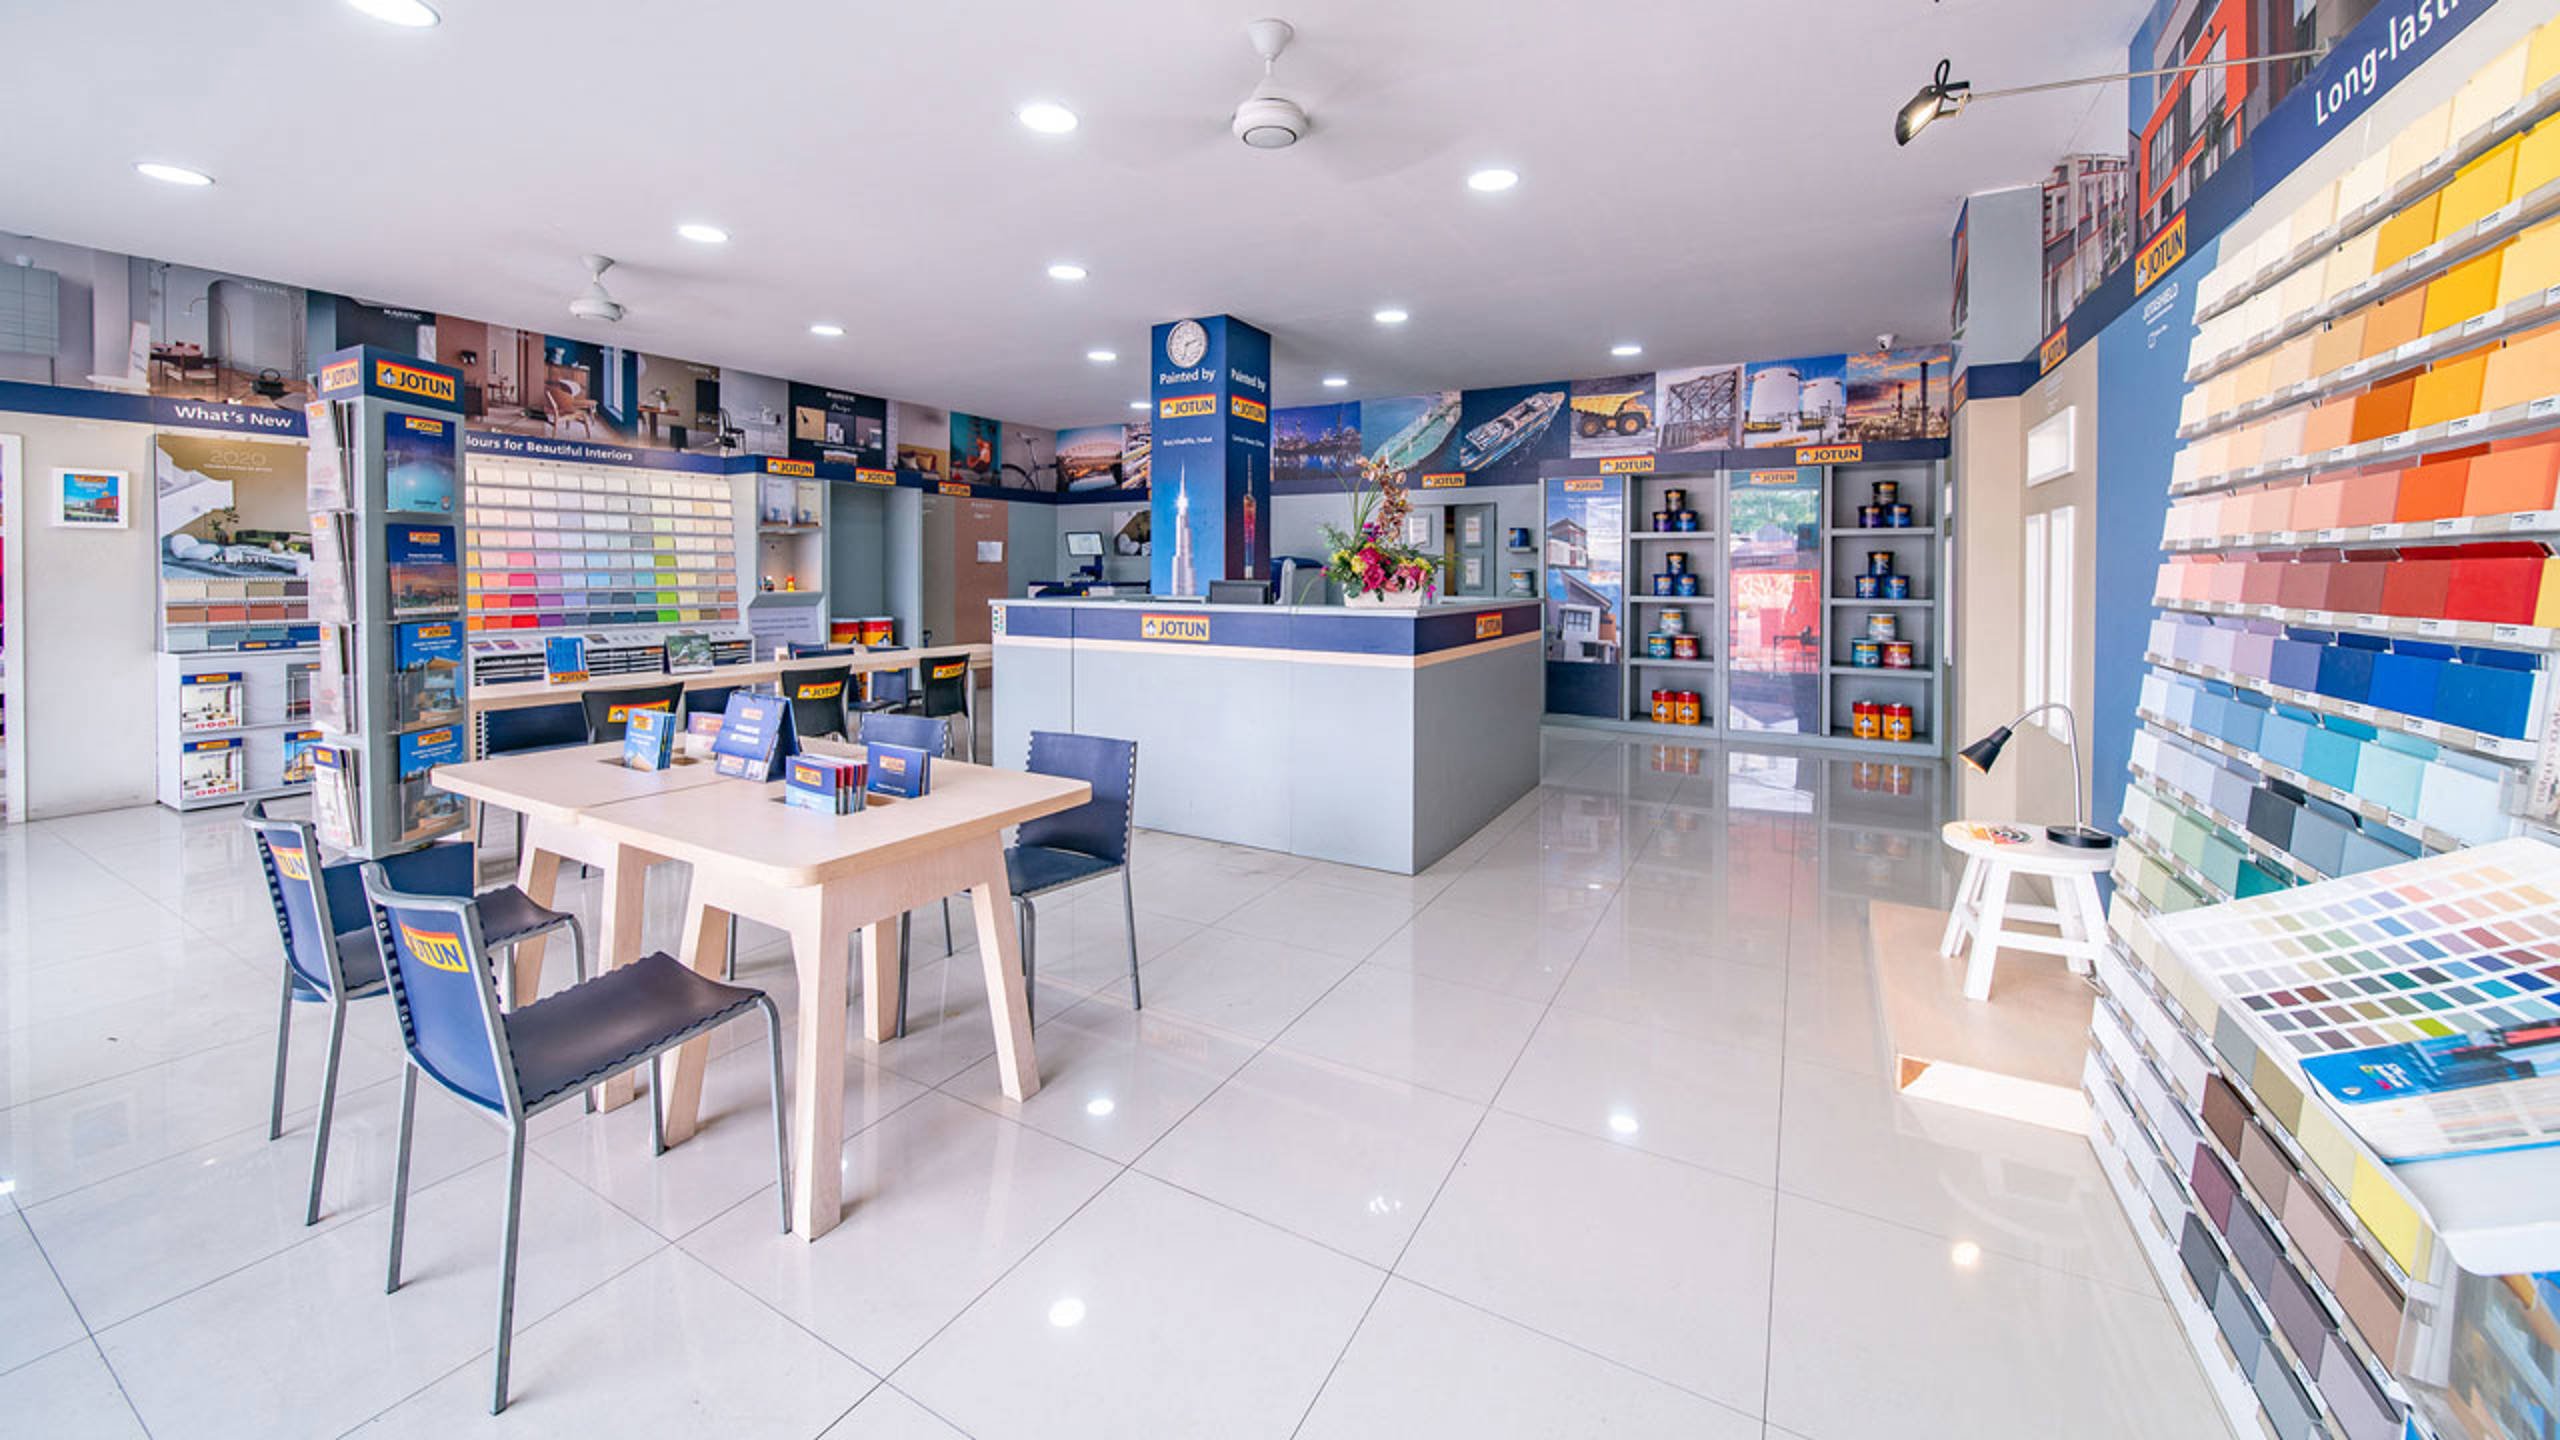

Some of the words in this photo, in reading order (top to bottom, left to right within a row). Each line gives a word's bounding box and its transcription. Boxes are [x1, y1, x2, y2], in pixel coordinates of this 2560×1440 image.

[2315, 0, 2459, 127] Long-last
[2147, 223, 2184, 281] JOTUN
[332, 364, 357, 387] JOTUN
[400, 371, 451, 397] JOTUN
[1160, 368, 1199, 385] Painted
[1202, 367, 1216, 383] by
[1231, 368, 1256, 387] Painted
[1257, 376, 1266, 393] by
[1175, 399, 1213, 415] JOTUN
[1241, 400, 1264, 419] JOTUN
[174, 405, 245, 424] What's
[251, 411, 292, 428] New
[465, 434, 500, 449] lours
[504, 438, 524, 450] for
[527, 441, 583, 457] Beautiful
[586, 447, 633, 461] Interiors
[1812, 448, 1859, 461] JOTUN
[780, 461, 813, 475] JOTUN
[1614, 458, 1652, 471] JOTUN
[865, 471, 895, 483] JOTUN
[1434, 475, 1464, 487] JOTUN
[1763, 473, 1796, 482] JOTUN
[1160, 619, 1207, 637] JOTUN
[811, 685, 841, 698] JOTUN
